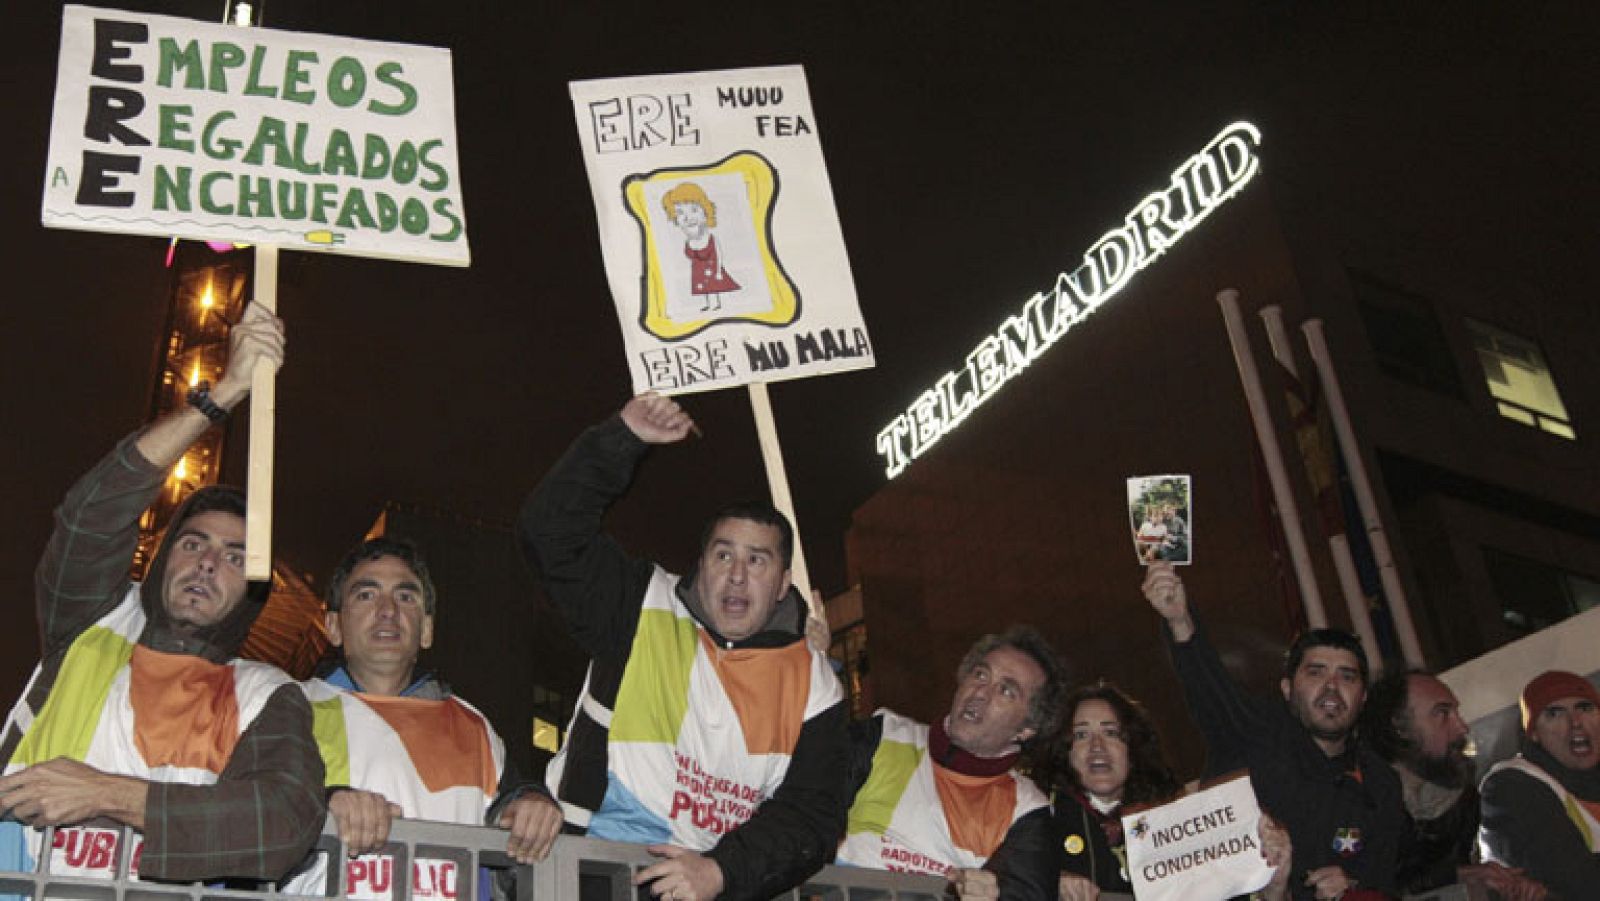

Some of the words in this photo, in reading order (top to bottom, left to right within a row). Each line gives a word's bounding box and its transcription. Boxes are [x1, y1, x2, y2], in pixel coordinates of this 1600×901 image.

[91, 18, 418, 117] EMPLEOS
[84, 85, 449, 192] REGALADOS
[588, 94, 701, 154] ERE
[717, 86, 784, 108] MUUU
[755, 115, 811, 137] FEA
[75, 150, 464, 242] ENCHUFADOS
[876, 120, 1262, 480] TELEMADRID
[640, 339, 736, 390] ERE
[743, 341, 790, 372] MU
[794, 327, 872, 364] MALA
[1143, 833, 1257, 883] CONDENADA
[1151, 805, 1236, 848] INOCENTE
